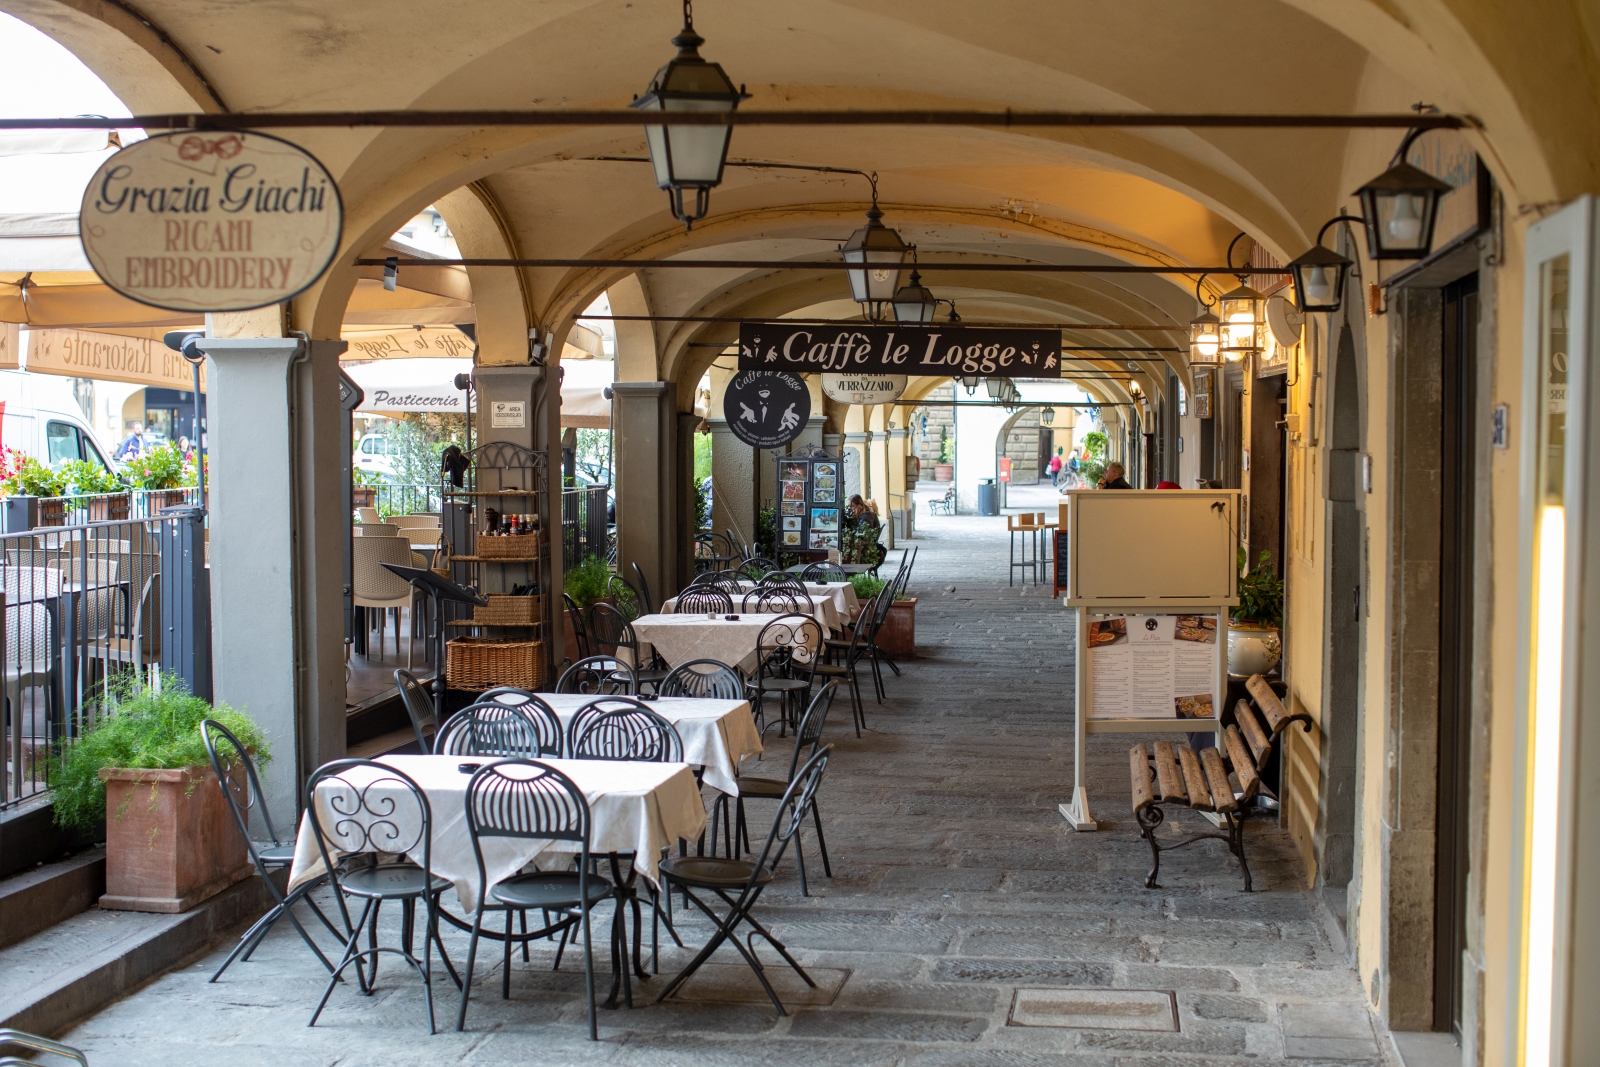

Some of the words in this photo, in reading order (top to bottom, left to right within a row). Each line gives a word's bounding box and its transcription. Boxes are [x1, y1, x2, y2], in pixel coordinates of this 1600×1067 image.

[95, 164, 209, 214] Grazia
[218, 163, 326, 213] Giachi
[164, 219, 253, 252] RICAMI
[125, 256, 292, 290] EMBROIDERY
[783, 331, 870, 370] Caffè
[882, 333, 909, 365] le
[919, 334, 1016, 373] Logge
[776, 372, 801, 390] Logge
[836, 380, 894, 392] VERRAZZANO
[373, 389, 459, 407] Pasticceria
